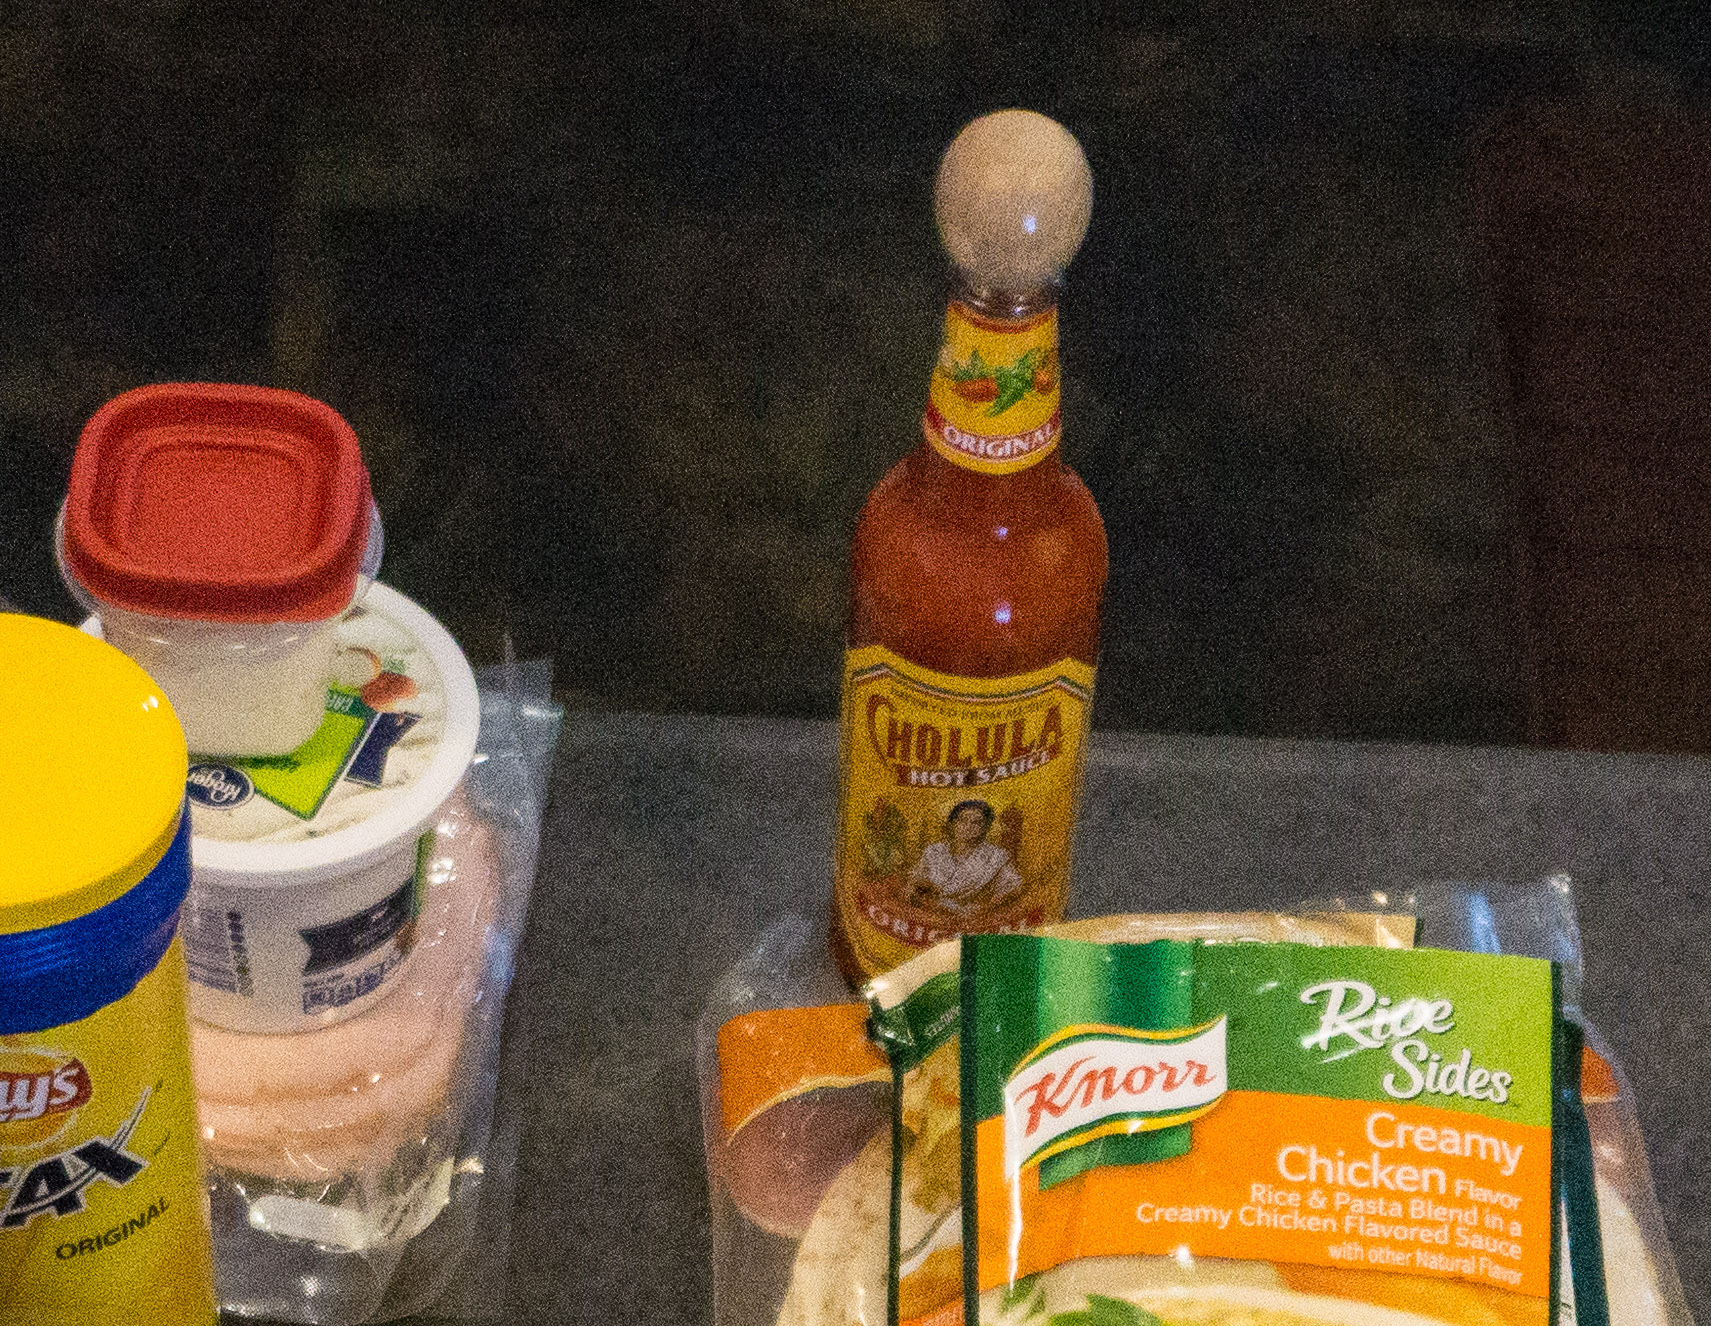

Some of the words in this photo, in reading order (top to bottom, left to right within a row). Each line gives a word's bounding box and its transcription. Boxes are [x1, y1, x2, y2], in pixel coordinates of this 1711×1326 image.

[867, 694, 1063, 768] CHOLULA
[909, 769, 967, 787] HOT
[1300, 978, 1456, 1051] Rice
[1014, 1055, 1218, 1138] Knorr
[1381, 1037, 1515, 1105] Sides
[1364, 1111, 1525, 1177] Creamy
[1249, 1183, 1303, 1210] Rice
[1309, 1188, 1330, 1211] &
[1335, 1191, 1404, 1220] Pasta
[1409, 1199, 1482, 1229] Blend
[1484, 1206, 1502, 1232] in
[1506, 1217, 1523, 1238] a
[1275, 1144, 1447, 1196] Chicken
[1453, 1179, 1523, 1212] Flavor
[54, 1196, 171, 1263] ORIGINAL
[1135, 1202, 1232, 1232] Creamy
[1238, 1205, 1338, 1236] Chicken
[1342, 1212, 1449, 1247] Flavored
[1454, 1226, 1523, 1261] Sauce
[1327, 1240, 1360, 1262] with
[1363, 1244, 1413, 1267] other
[1415, 1249, 1477, 1278] Natural
[1477, 1256, 1525, 1288] Flavor
